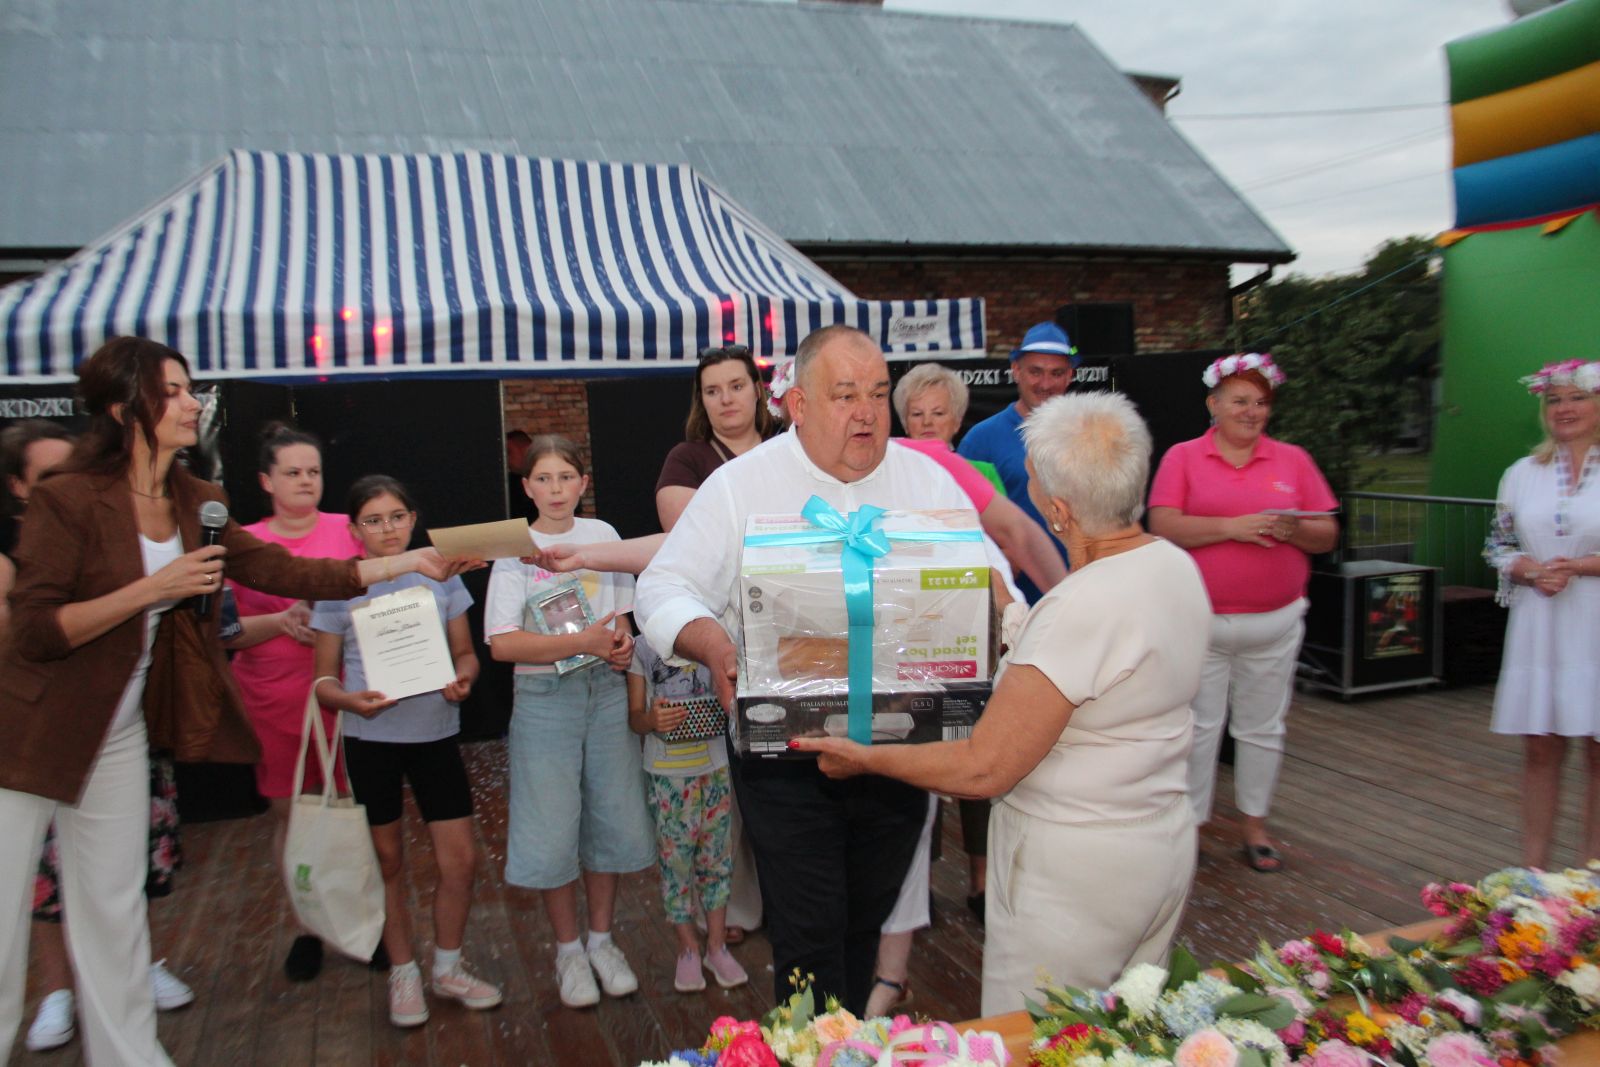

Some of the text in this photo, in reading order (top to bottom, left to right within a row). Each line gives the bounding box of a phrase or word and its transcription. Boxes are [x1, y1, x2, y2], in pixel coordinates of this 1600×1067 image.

[952, 368, 1001, 385] IDZKI
[956, 635, 977, 645] set
[932, 647, 977, 656] Bread
[826, 700, 849, 708] QUALIT
